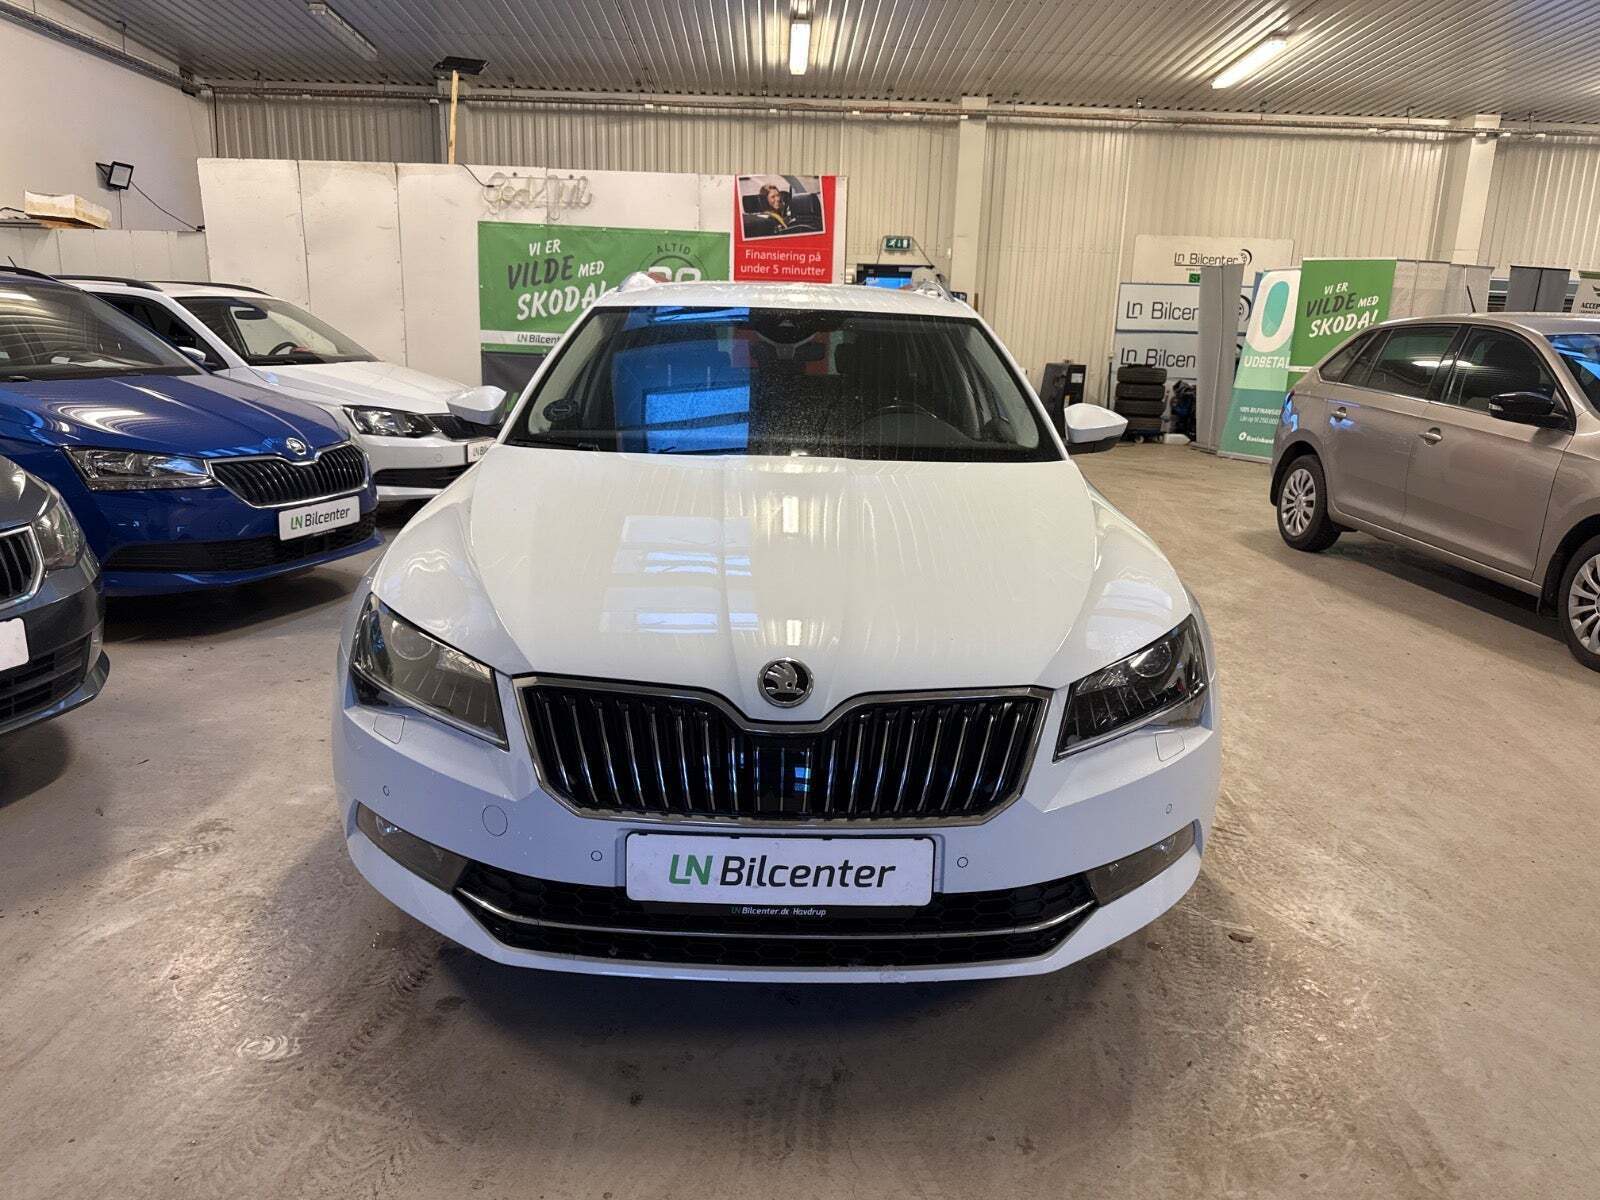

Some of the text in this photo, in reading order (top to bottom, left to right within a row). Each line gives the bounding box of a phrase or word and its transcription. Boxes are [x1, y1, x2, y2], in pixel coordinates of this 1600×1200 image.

[529, 239, 561, 256] VI ER
[657, 243, 691, 255] ALTID
[745, 249, 822, 264] Finansiering på
[1189, 251, 1239, 265] Bilcenter
[507, 254, 605, 290] VILDE MED
[740, 264, 826, 276] under 5 minutter
[1324, 282, 1349, 295] VI ER
[1306, 292, 1379, 317] VILDE MED
[1309, 309, 1379, 338] SKODA!
[291, 507, 350, 530] LN Bilcenter
[669, 854, 896, 888] LN Bilcenter
[793, 907, 826, 917] Havdrup
